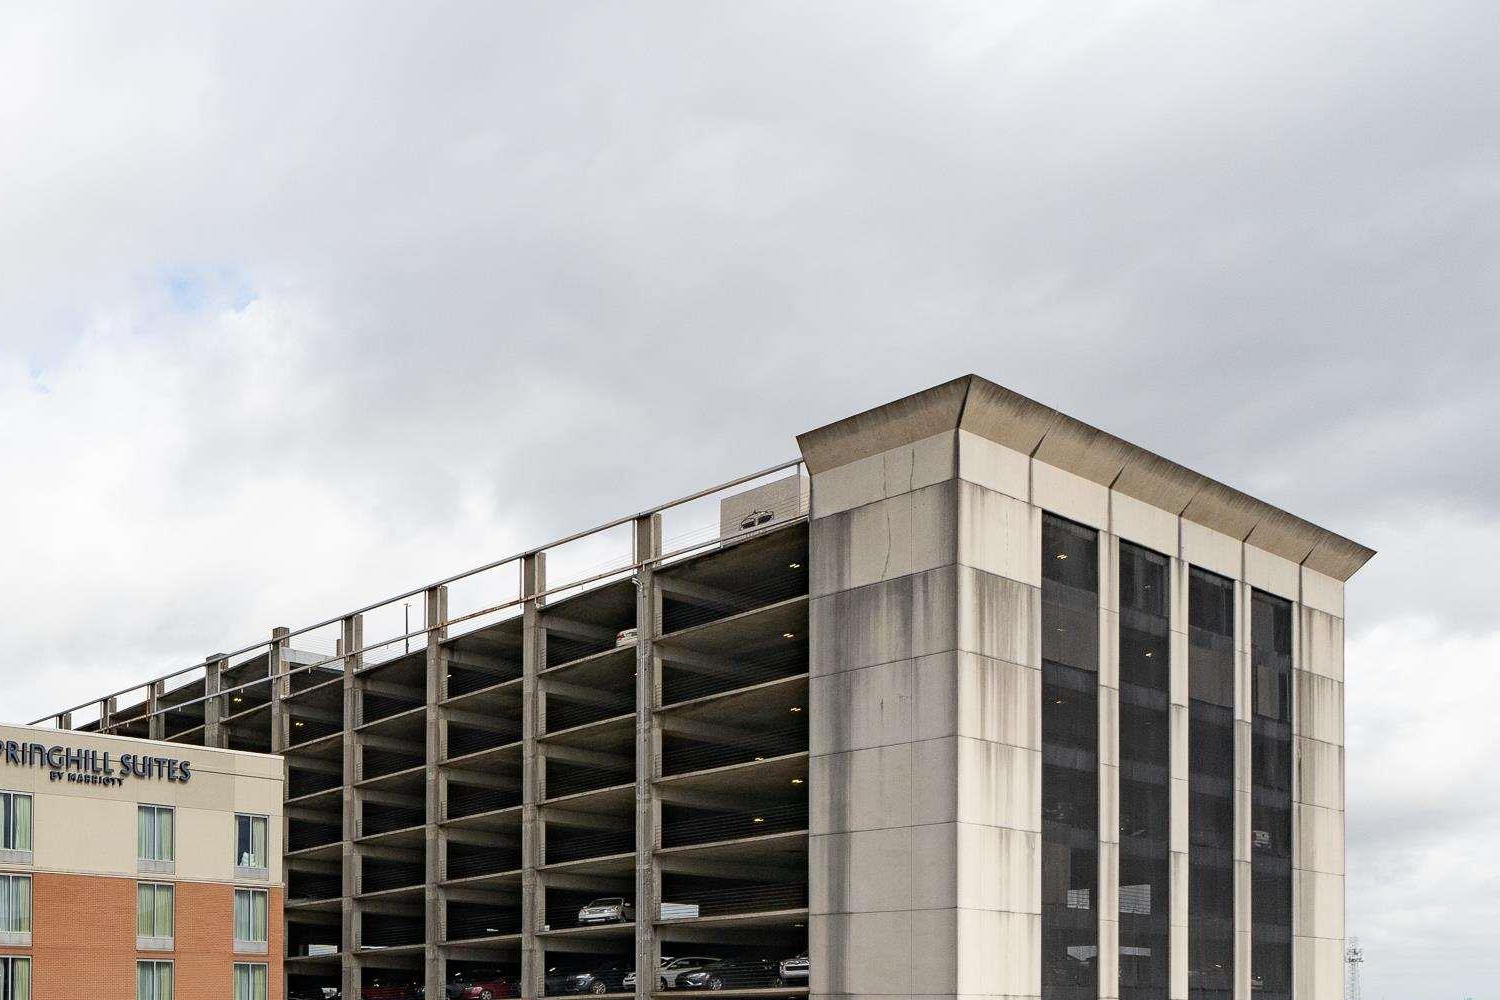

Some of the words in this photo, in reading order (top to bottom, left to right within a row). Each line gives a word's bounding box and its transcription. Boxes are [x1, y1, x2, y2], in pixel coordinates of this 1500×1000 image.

[49, 771, 65, 782] BY
[67, 773, 125, 787] MARRIOTT
[120, 753, 192, 783] SUITES
